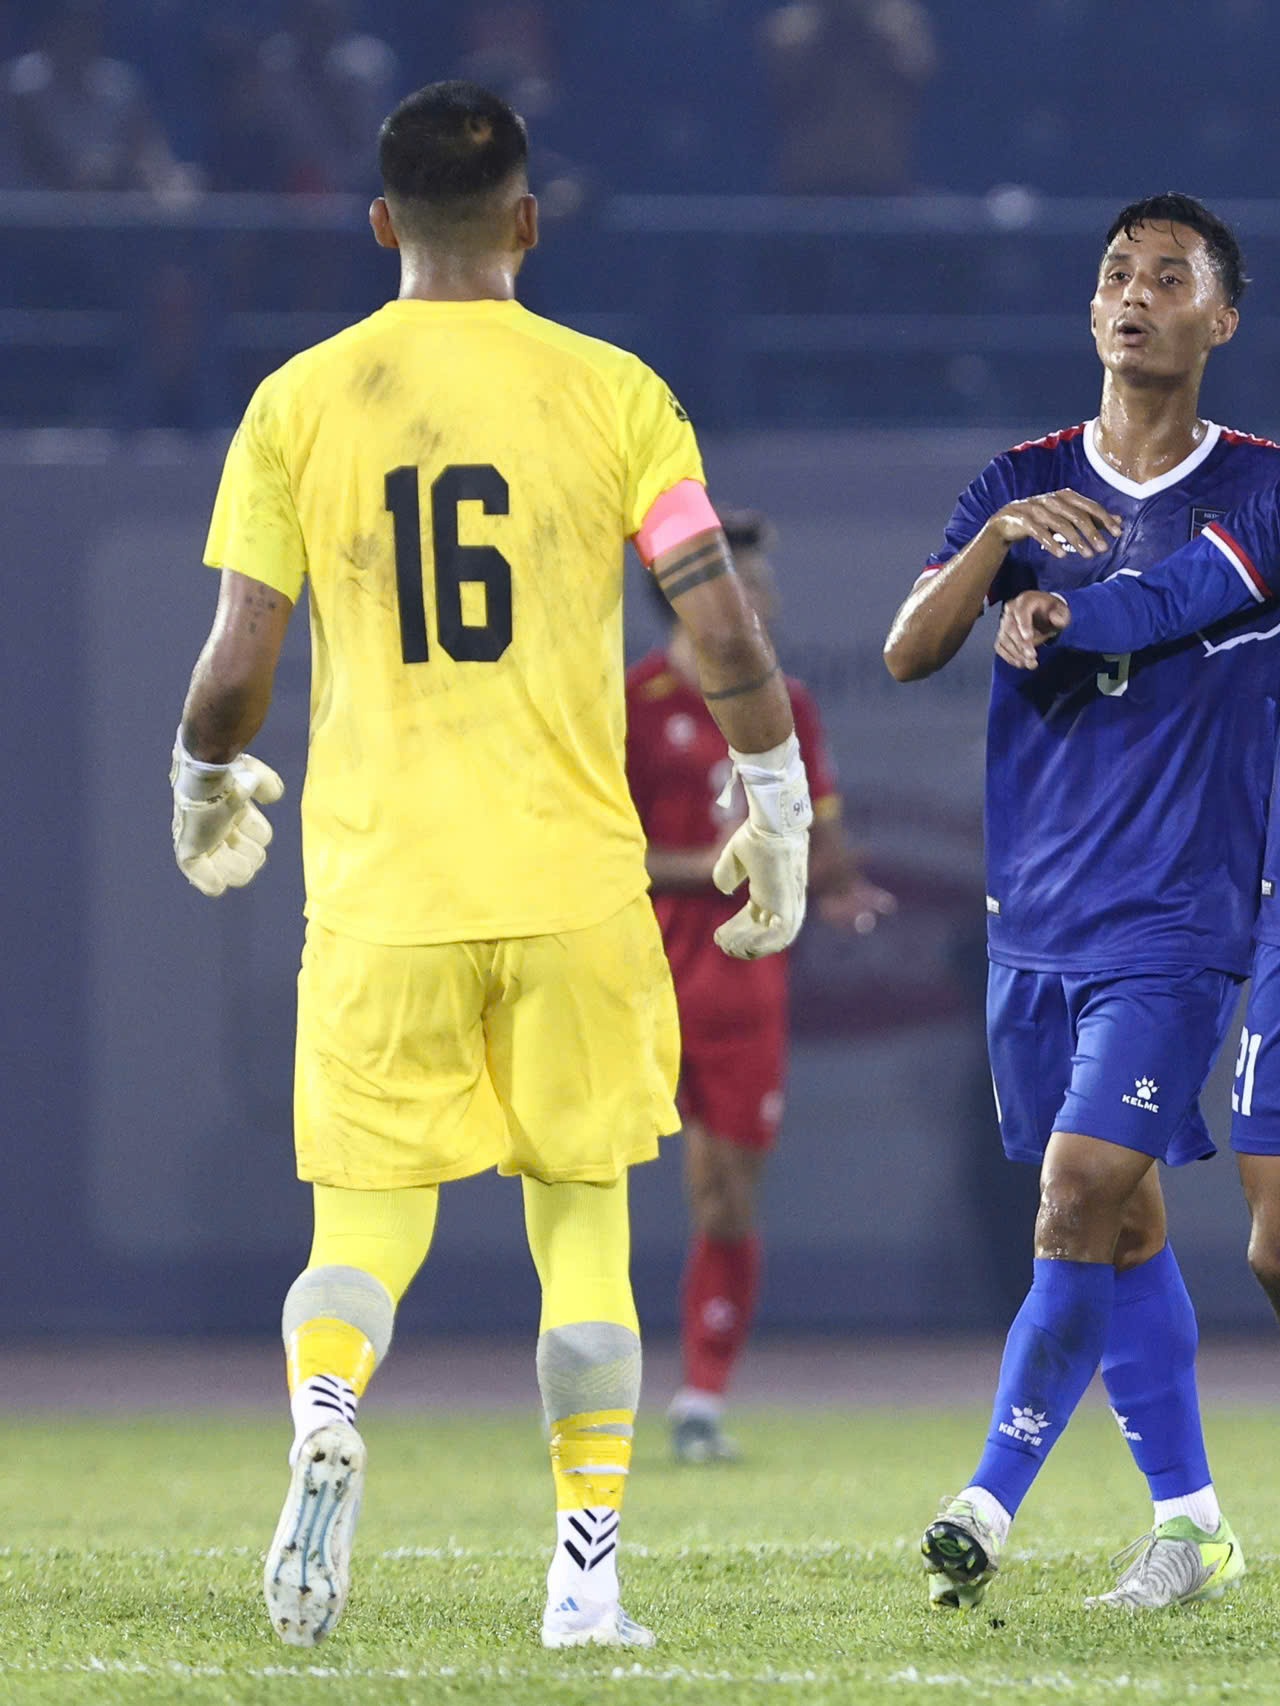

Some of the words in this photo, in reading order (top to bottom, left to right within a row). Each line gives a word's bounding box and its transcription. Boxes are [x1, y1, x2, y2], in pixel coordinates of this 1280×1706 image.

[384, 463, 513, 665] 16
[1122, 1094, 1160, 1113] KELME
[999, 1422, 1044, 1447] KELME
